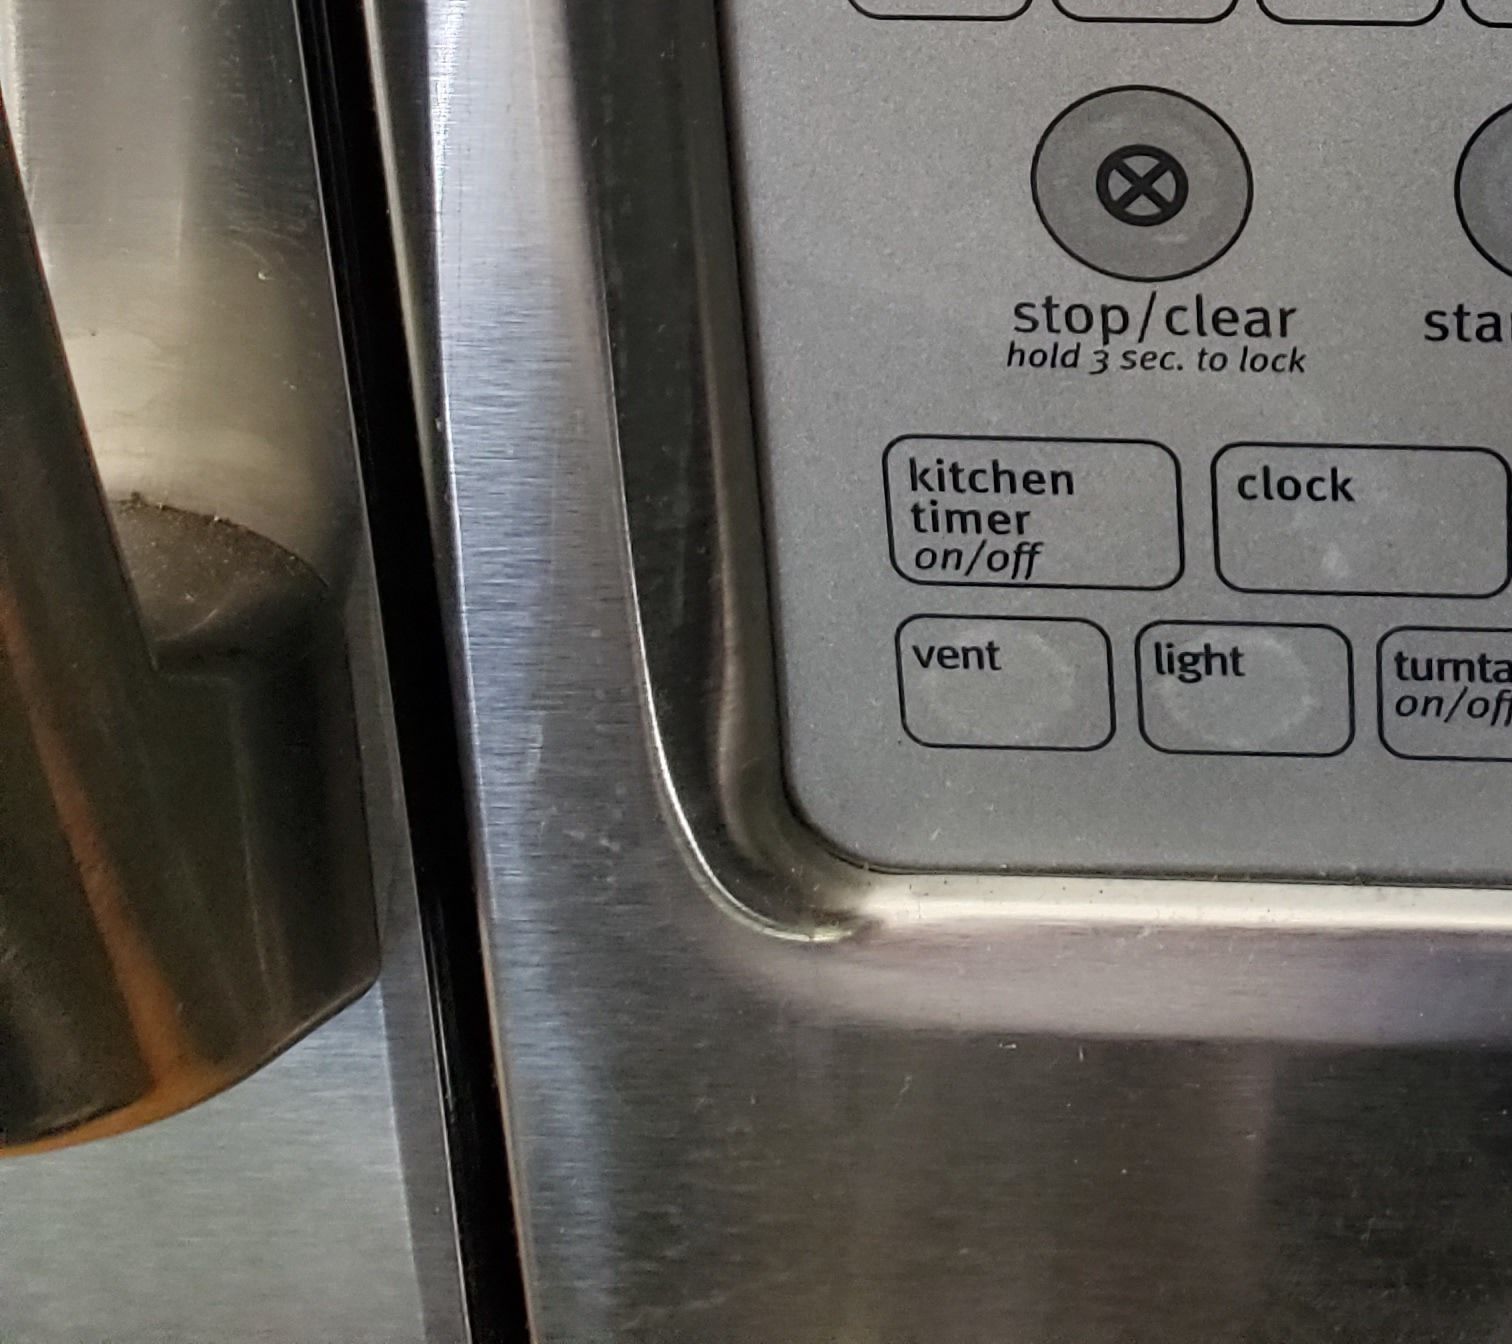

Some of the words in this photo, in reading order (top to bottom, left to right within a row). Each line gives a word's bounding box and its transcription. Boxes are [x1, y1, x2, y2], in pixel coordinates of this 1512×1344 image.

[1014, 291, 1296, 346] stop/clear
[1007, 341, 1081, 368] hold
[1089, 350, 1109, 375] 3
[1121, 350, 1184, 370] sec.
[1198, 348, 1228, 372] to
[1240, 346, 1305, 373] lock
[909, 458, 1073, 496] kitchen
[1238, 465, 1354, 502] clock
[911, 499, 1030, 535] timer
[915, 540, 1043, 581] on/off
[912, 641, 1001, 670] vent
[1154, 642, 1244, 684] light
